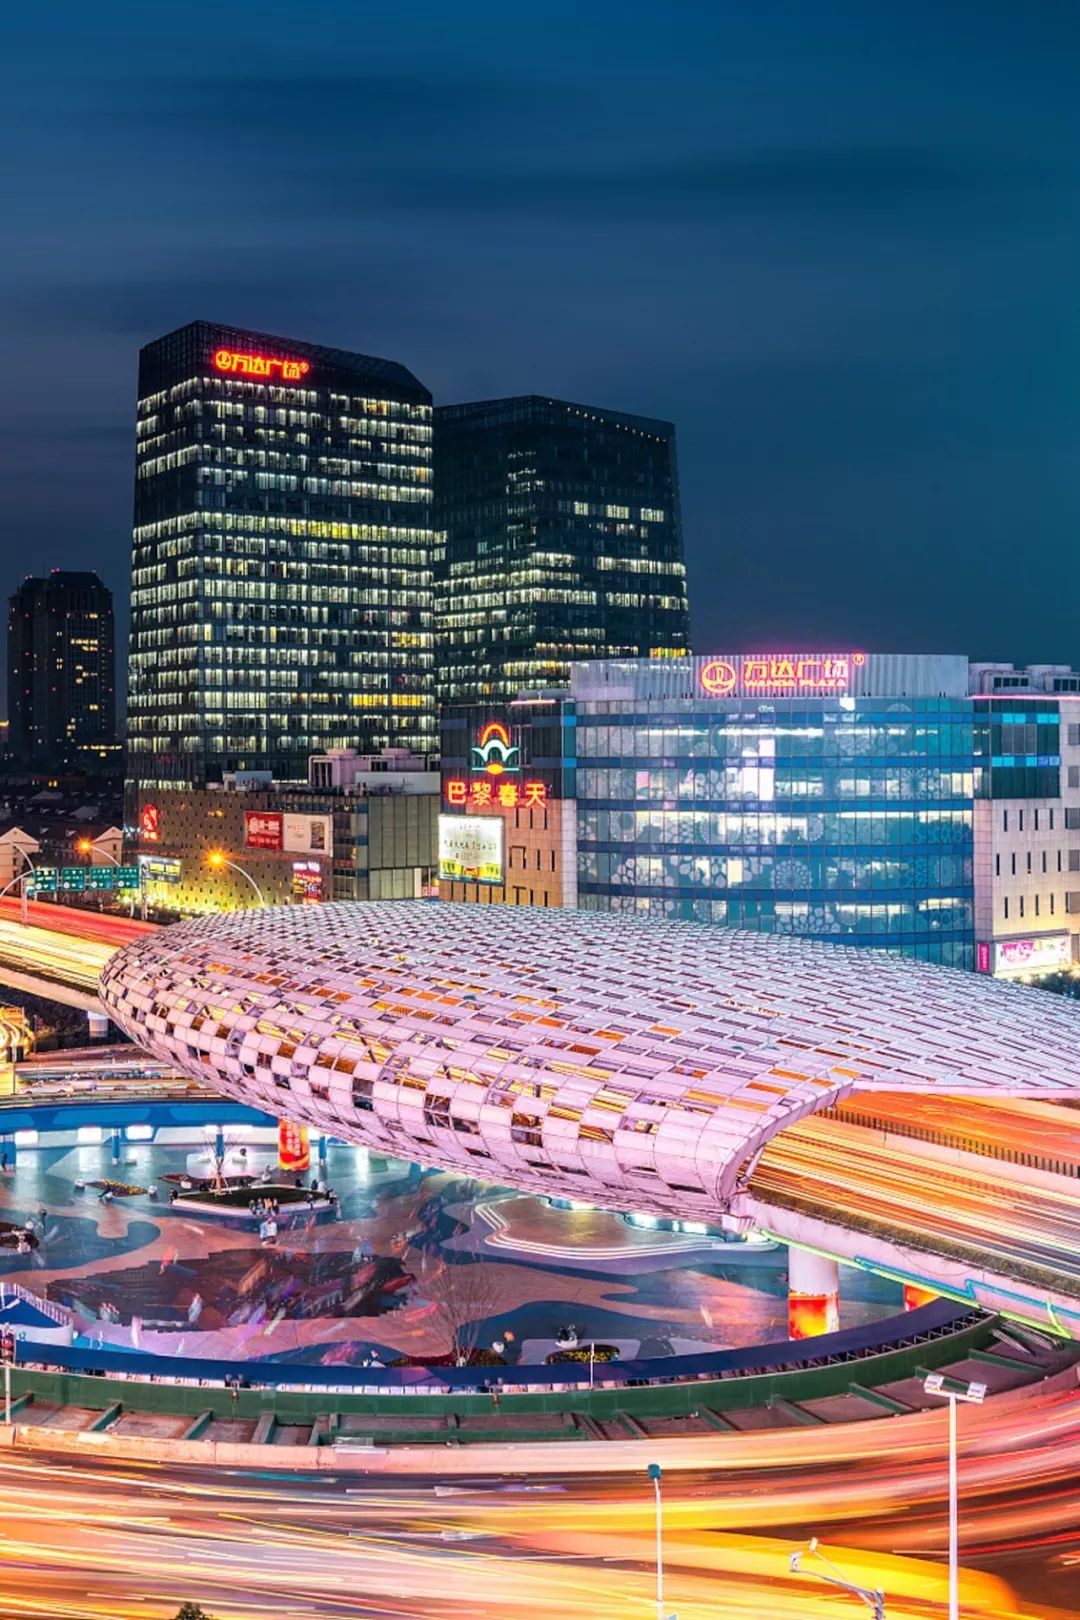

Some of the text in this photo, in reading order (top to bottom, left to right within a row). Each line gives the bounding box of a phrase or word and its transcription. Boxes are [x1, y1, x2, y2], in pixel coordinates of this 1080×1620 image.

[231, 354, 300, 379] 万达广场
[743, 659, 849, 679] 万达广场
[744, 679, 847, 687] WANDA PLAZA
[447, 781, 547, 808] 巴黎春天
